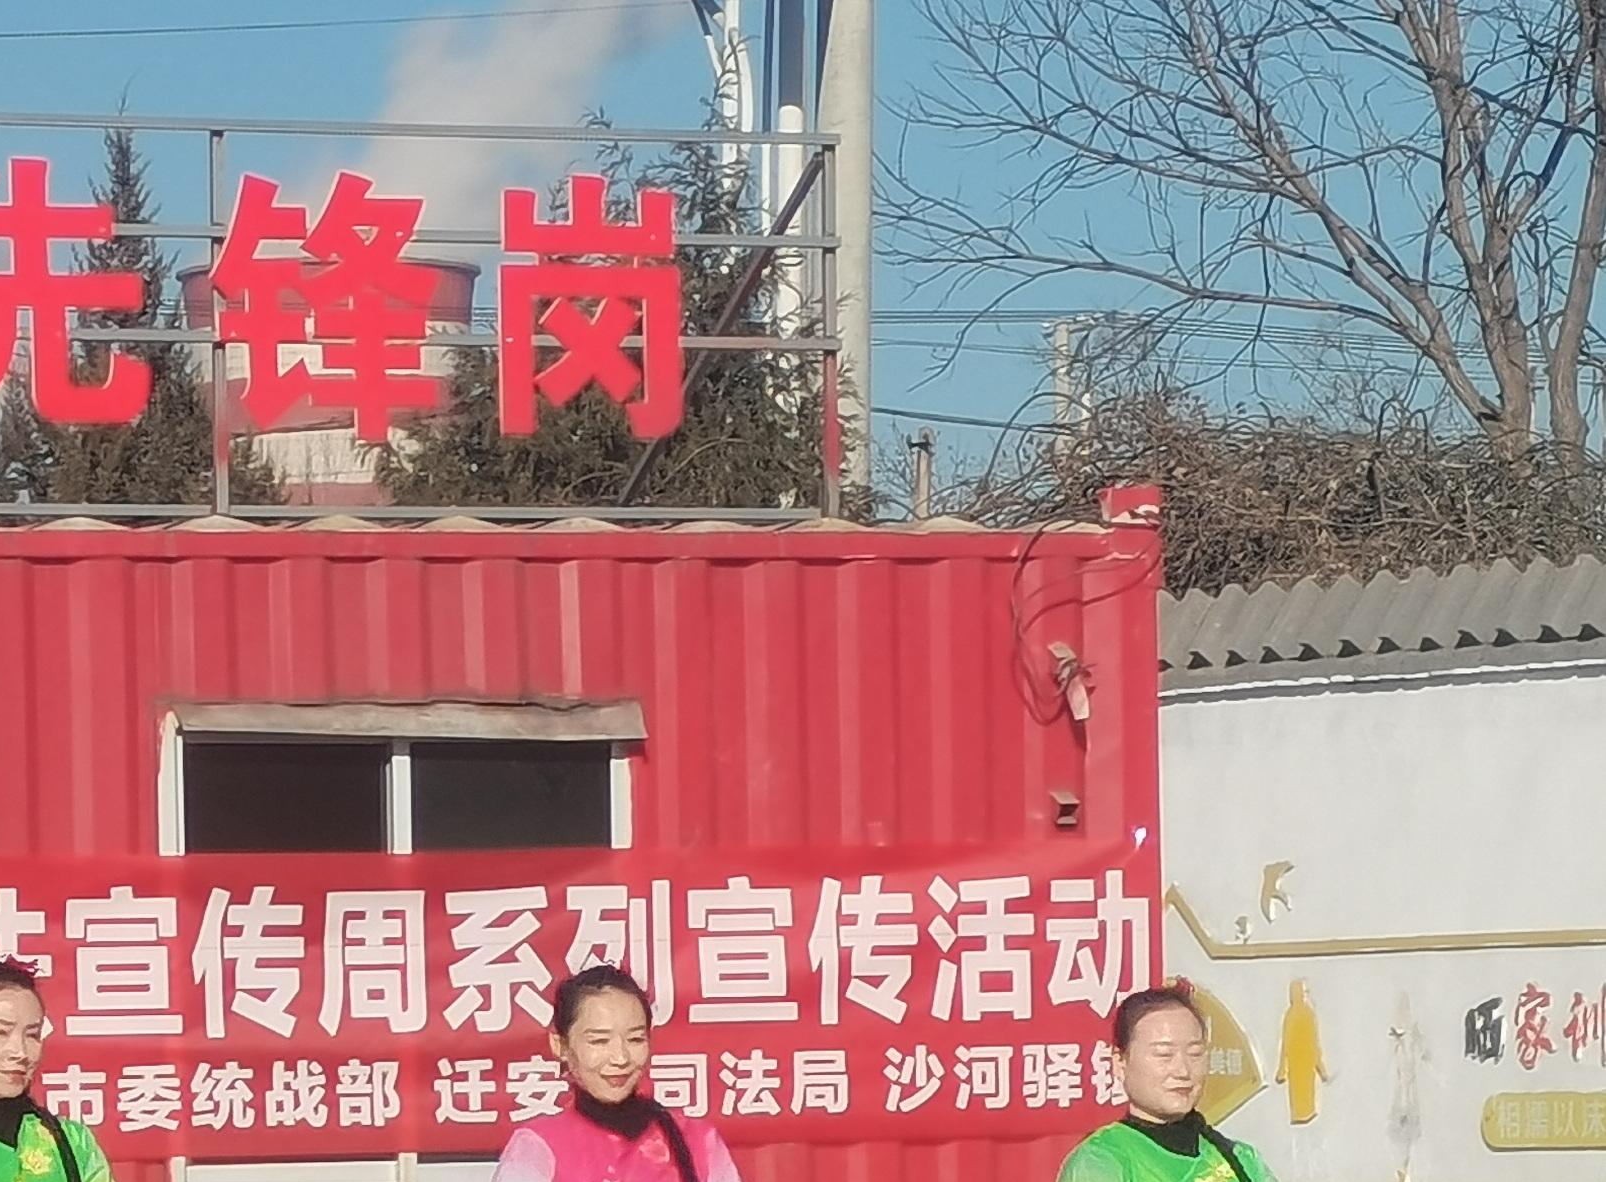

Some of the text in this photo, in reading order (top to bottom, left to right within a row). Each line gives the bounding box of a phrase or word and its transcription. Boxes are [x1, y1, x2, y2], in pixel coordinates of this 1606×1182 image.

[434, 1049, 849, 1125] 迁安司法局
